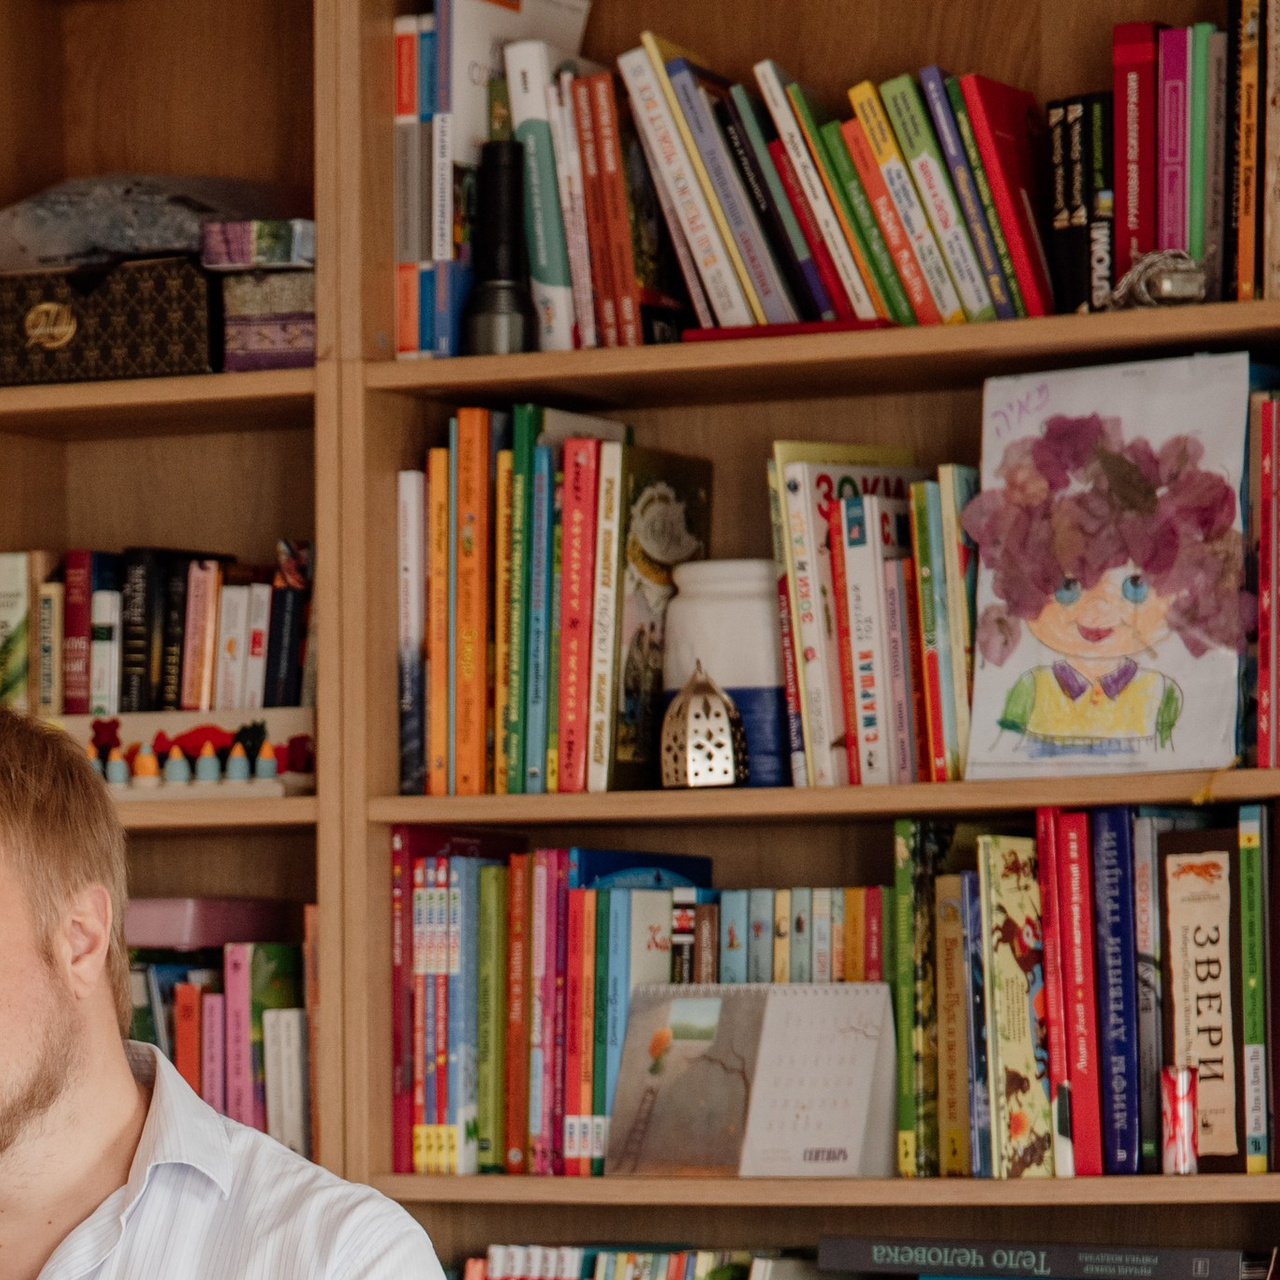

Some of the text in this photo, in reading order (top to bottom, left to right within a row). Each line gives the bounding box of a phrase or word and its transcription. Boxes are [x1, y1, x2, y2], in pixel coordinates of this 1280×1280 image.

[797, 576, 813, 624] ЗОКИ
[852, 583, 864, 640] КРУГЛЫЙ
[863, 615, 872, 640] ГОД
[1133, 861, 1152, 951] НАСКВОЗЬ
[940, 936, 961, 1024] Винни-Пух
[1099, 829, 1129, 1130] МИФЫ ДРЕВНЕЙ ГРЕЦИИ
[1191, 924, 1227, 1083] ЗВЕРИ
[871, 1244, 1051, 1276] Тело человека
